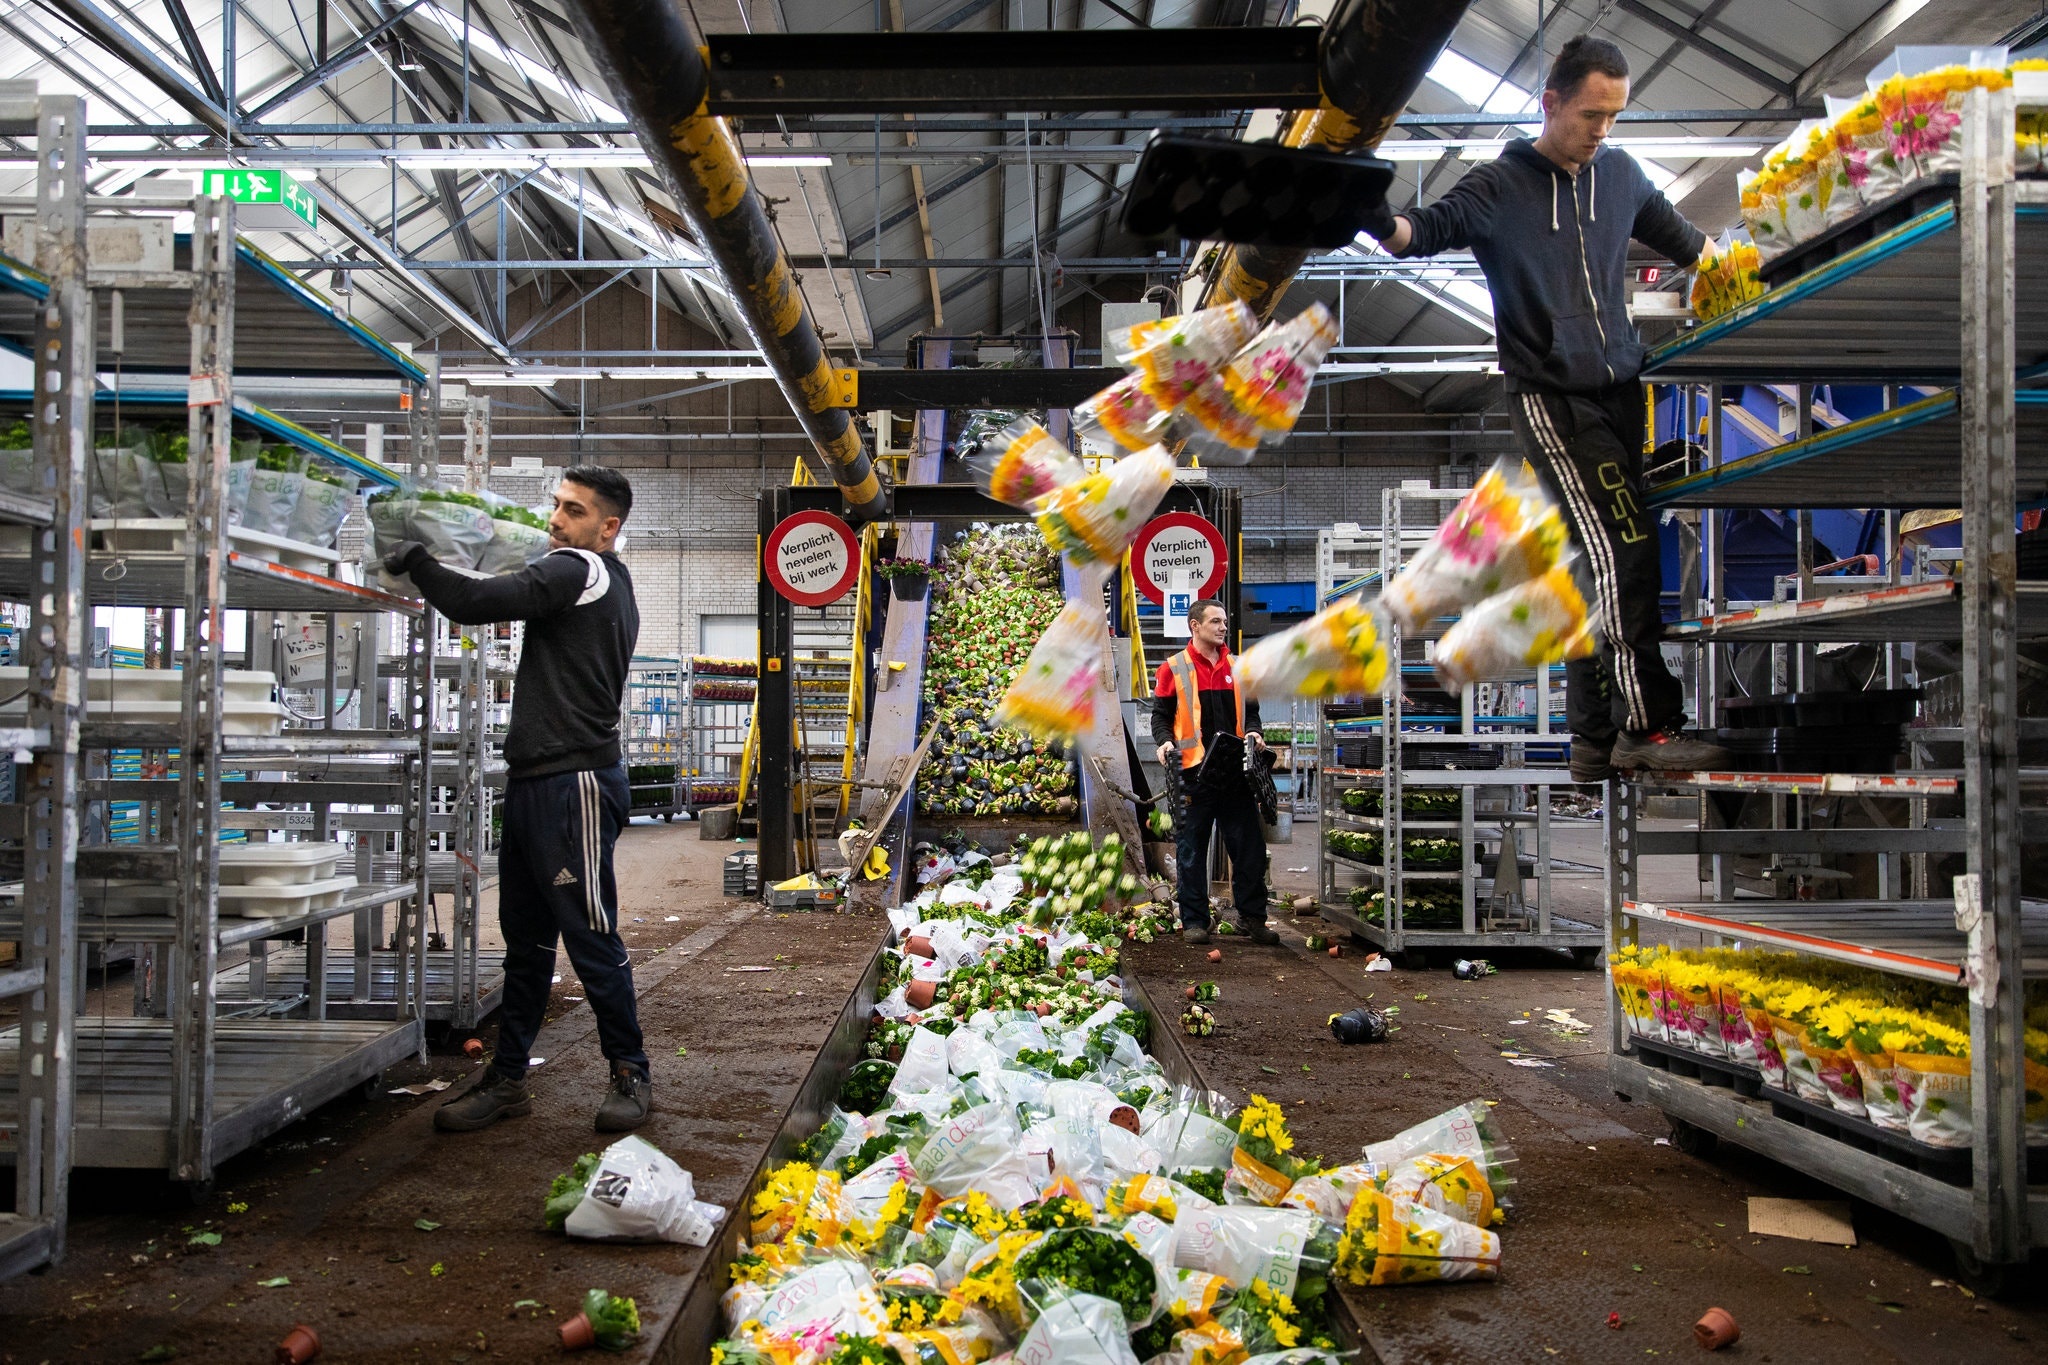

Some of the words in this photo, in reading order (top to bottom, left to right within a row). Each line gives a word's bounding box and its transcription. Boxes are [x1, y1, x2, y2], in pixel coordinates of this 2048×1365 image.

[780, 531, 836, 556] Verplicht
[1151, 538, 1208, 554] Verplicht
[785, 549, 833, 571] nevelen
[1152, 554, 1201, 568] nevelen
[788, 571, 806, 585] bij
[807, 561, 839, 579] werk
[1153, 571, 1168, 584] bij
